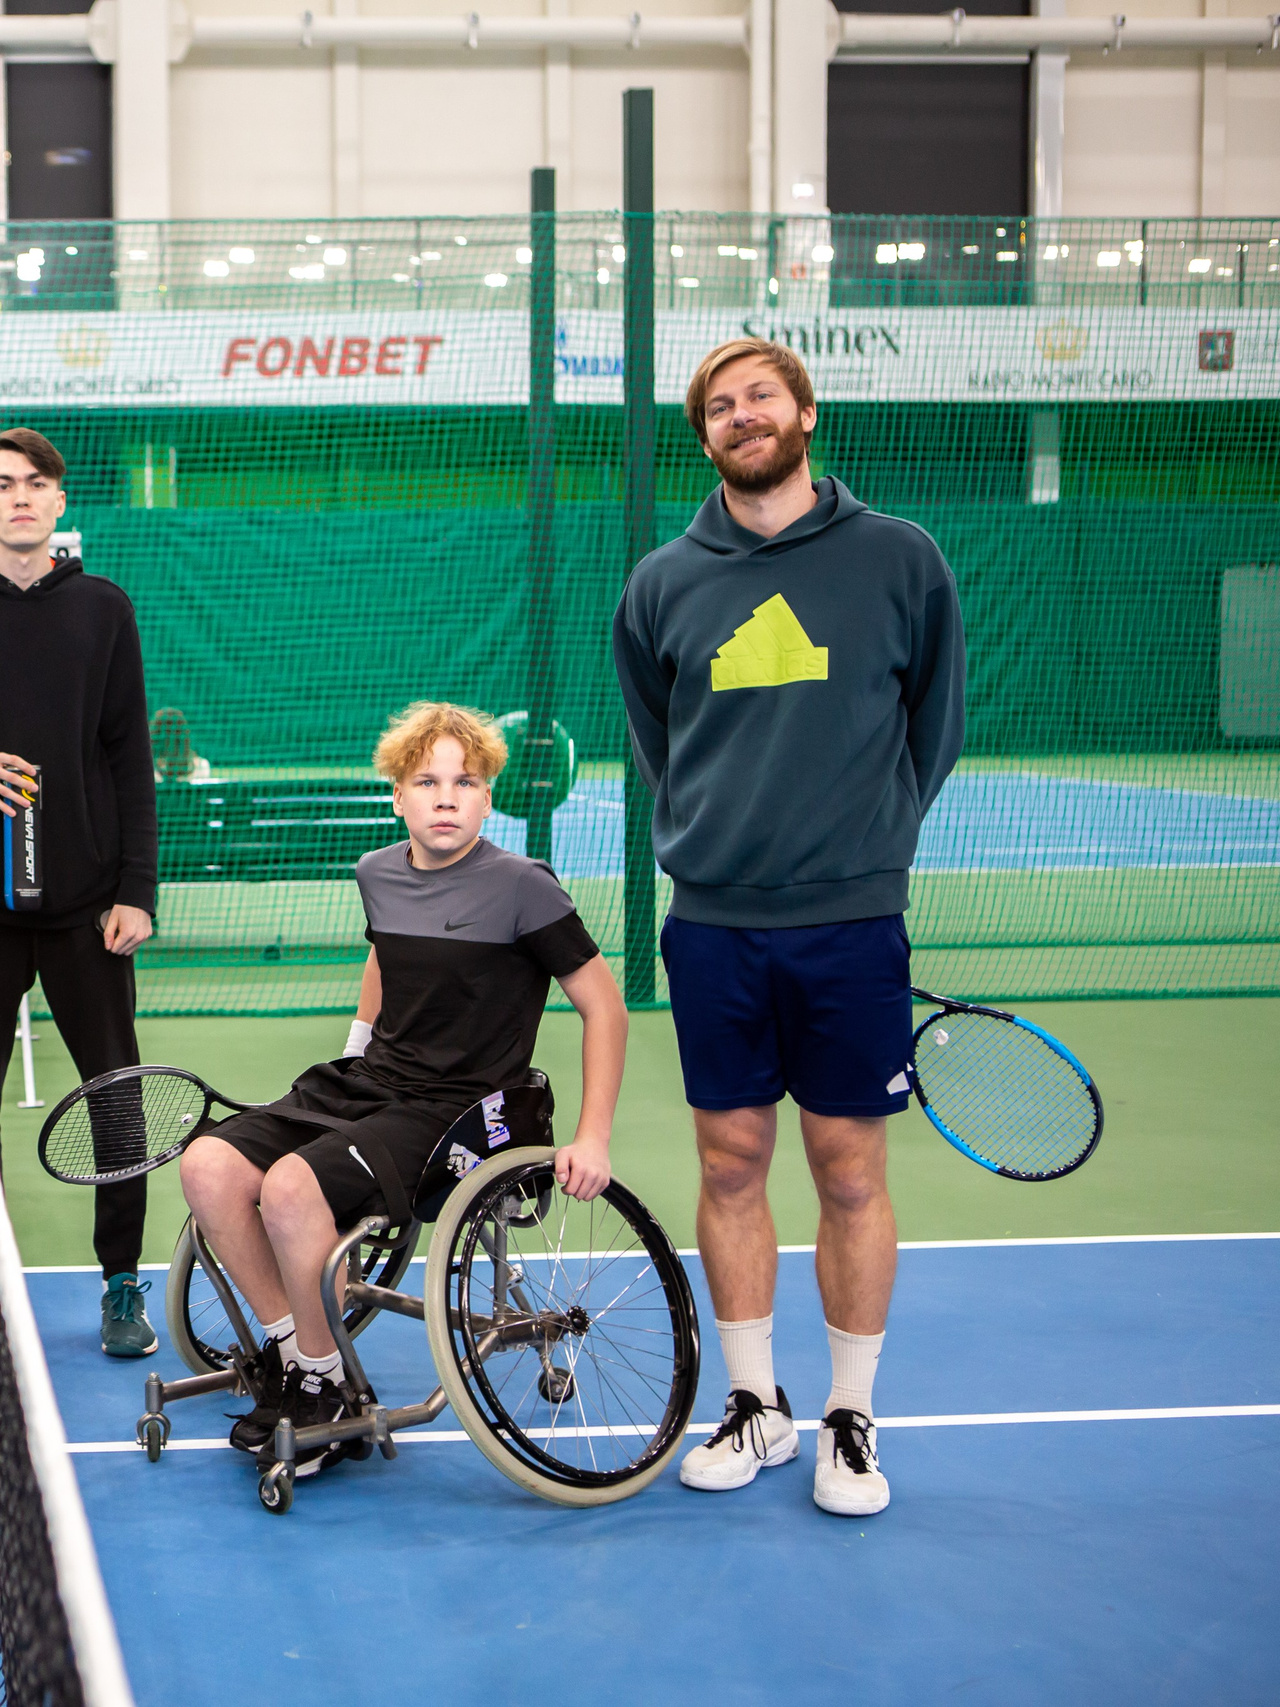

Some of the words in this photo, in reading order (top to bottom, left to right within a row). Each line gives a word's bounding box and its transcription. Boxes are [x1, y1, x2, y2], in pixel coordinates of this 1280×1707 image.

[220, 335, 444, 378] FONBET
[25, 806, 34, 840] NEVA
[25, 840, 35, 883] SPORT
[303, 1373, 323, 1385] NIKE
